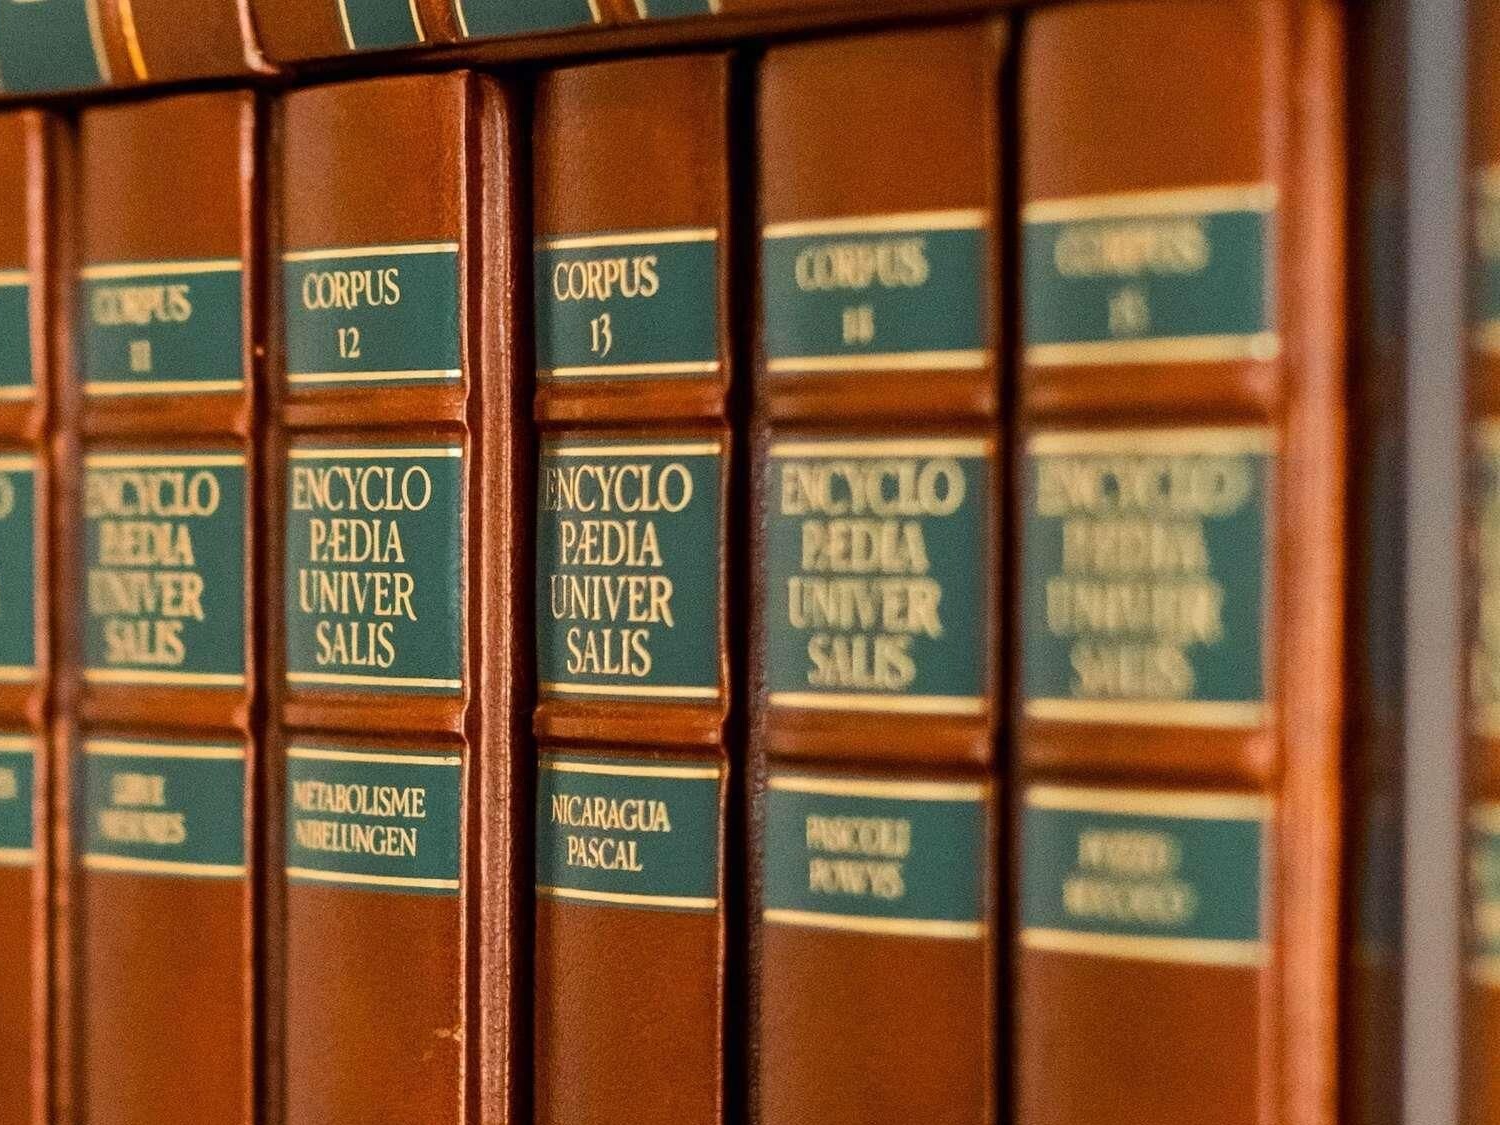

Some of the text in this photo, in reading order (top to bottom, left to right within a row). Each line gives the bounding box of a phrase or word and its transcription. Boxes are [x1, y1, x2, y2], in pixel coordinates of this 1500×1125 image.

[553, 254, 659, 302] CORPUS
[795, 237, 930, 292] CORPUS
[303, 268, 400, 310] CORPUS
[338, 328, 361, 359] 12
[590, 313, 613, 359] 13
[291, 464, 432, 513] ENCYCLO
[545, 461, 693, 515] ENCYCLO
[781, 460, 966, 517] ENCYCLO
[310, 518, 405, 564] PÆDIA
[561, 520, 663, 567] PÆDIA
[300, 570, 418, 622] UNIVER
[550, 573, 675, 627] UNIVER
[787, 577, 943, 640] UNIVER
[104, 619, 186, 666] SALIS
[315, 620, 396, 668] SALIS
[566, 626, 653, 678] SALIS
[807, 634, 917, 691] SALIS
[292, 780, 426, 819] METABOLISME
[551, 793, 671, 833] NICARAGUA
[294, 820, 418, 858] NIBELUNGEN
[566, 835, 643, 873] PASCAL
